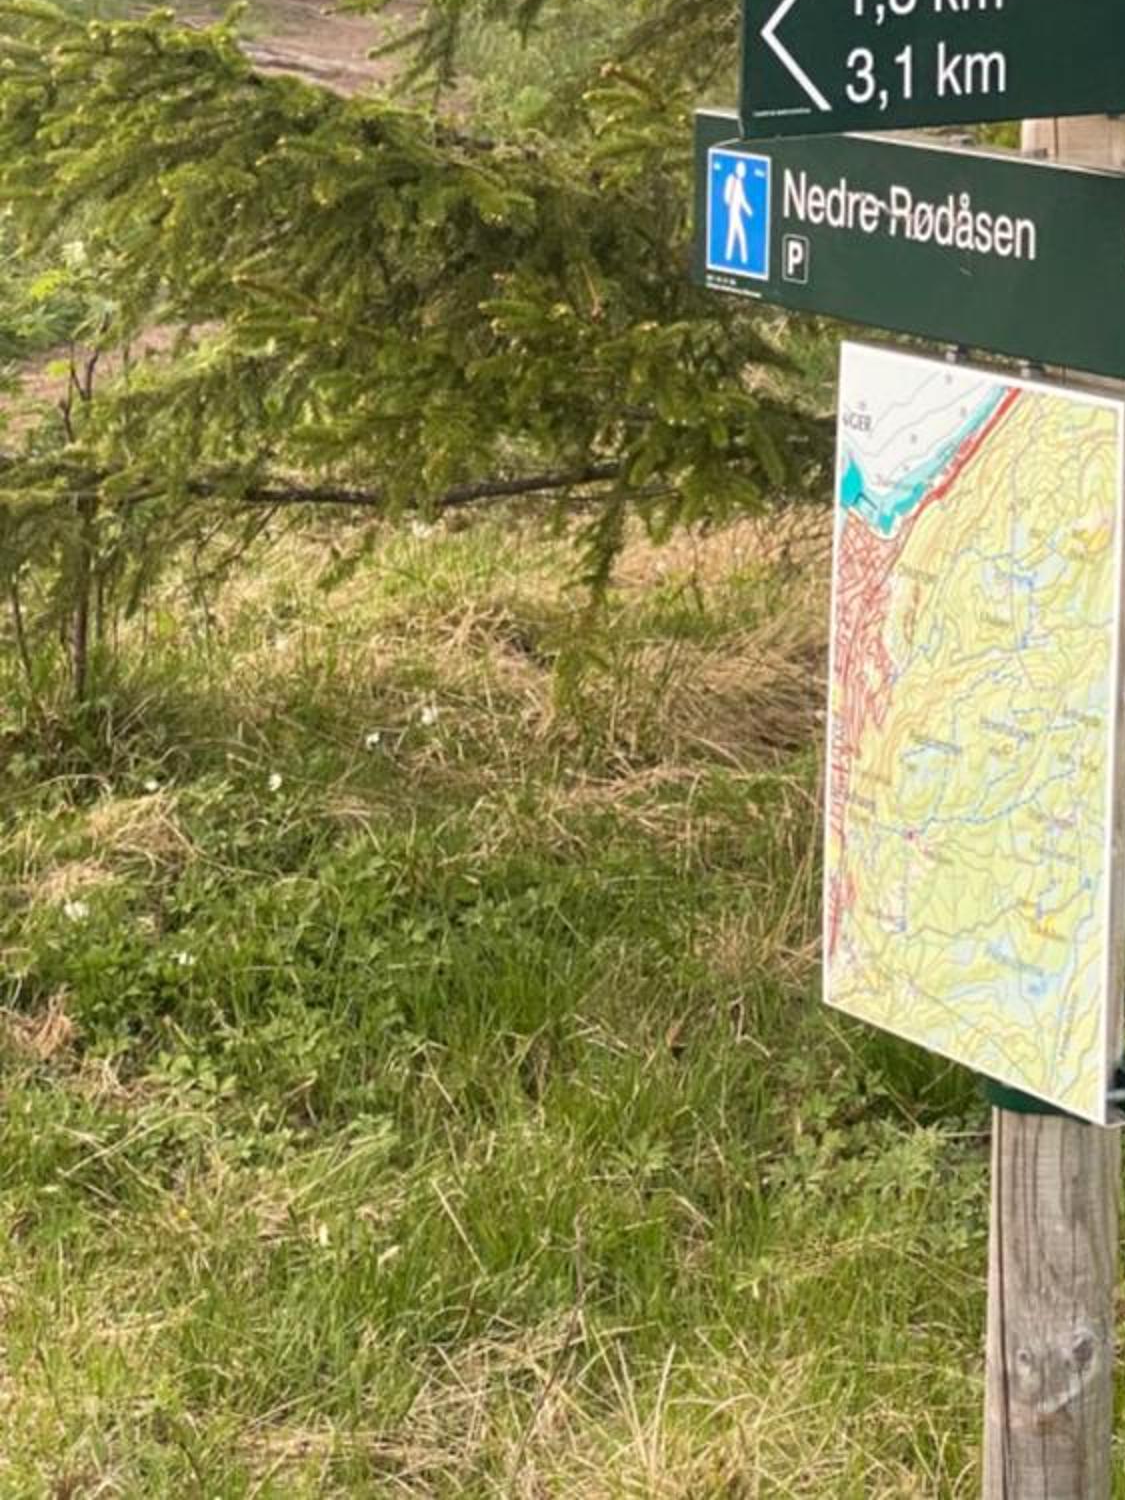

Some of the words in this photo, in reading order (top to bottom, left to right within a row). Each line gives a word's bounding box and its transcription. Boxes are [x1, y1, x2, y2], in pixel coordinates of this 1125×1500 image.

[846, 45, 912, 110] 3,1
[937, 42, 1006, 96] km
[783, 168, 880, 233] Nedre
[889, 185, 1036, 260] Rødåsen
[787, 240, 804, 275] P
